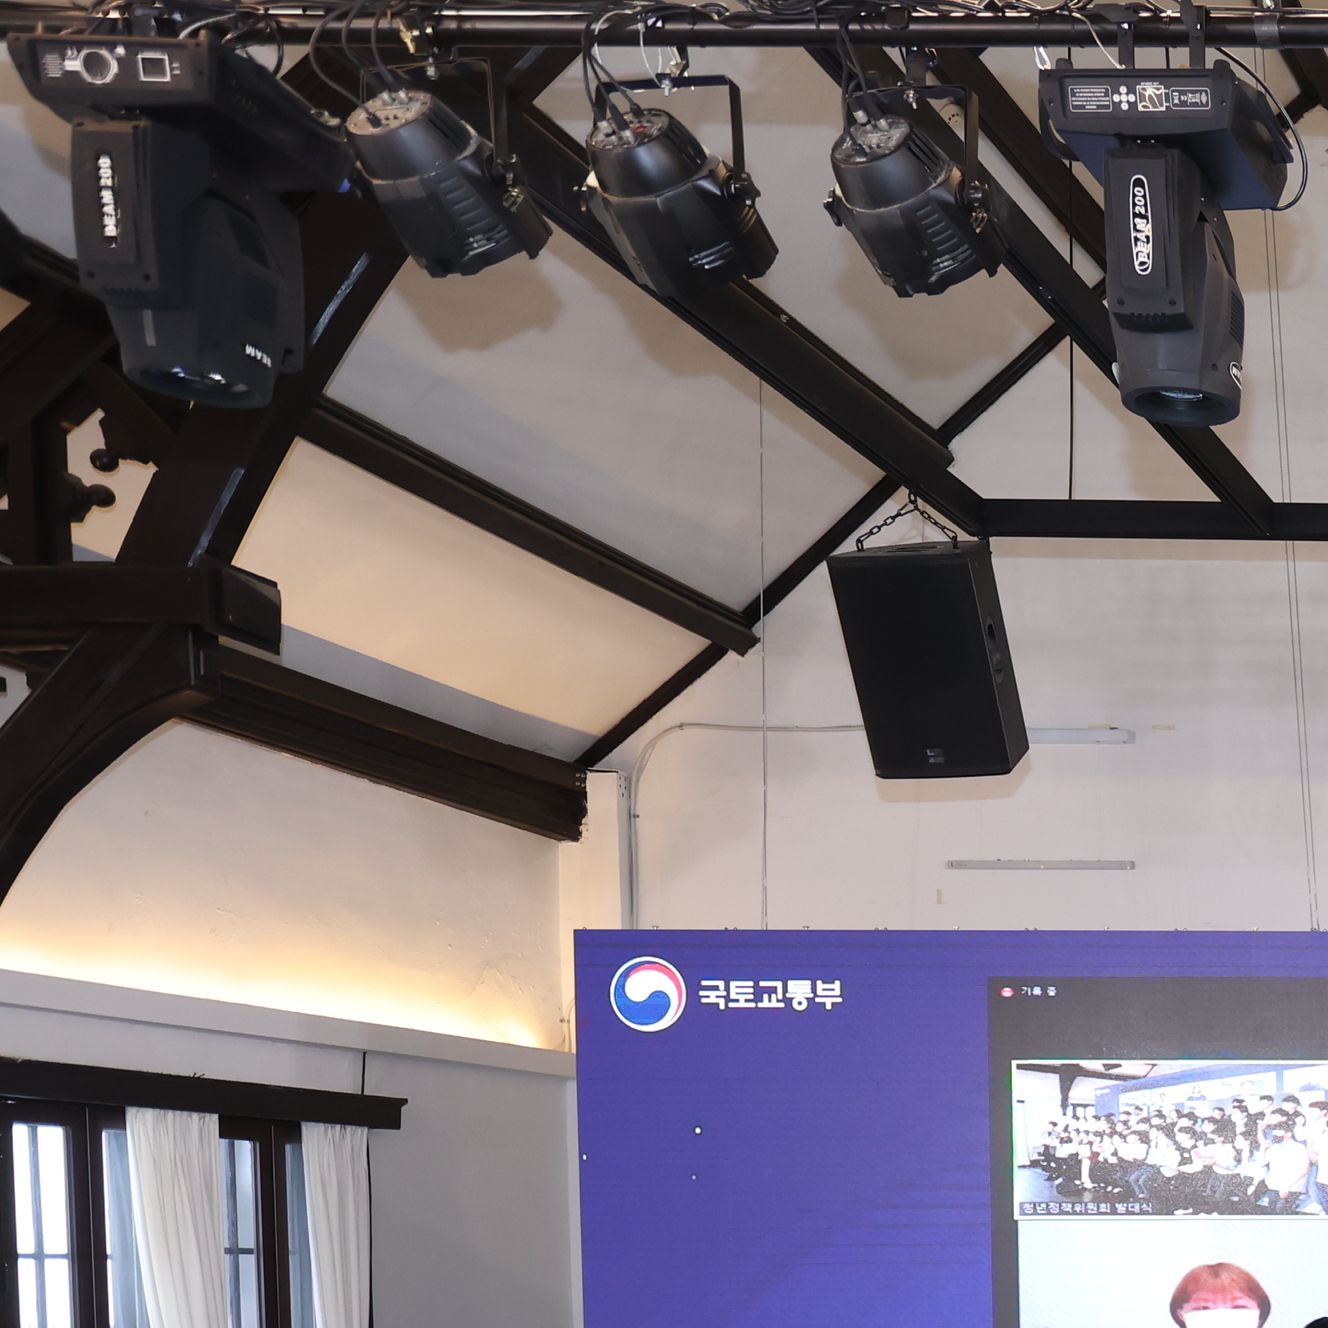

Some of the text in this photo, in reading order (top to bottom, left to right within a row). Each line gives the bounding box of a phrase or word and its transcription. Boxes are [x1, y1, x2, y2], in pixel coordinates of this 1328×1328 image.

[97, 154, 117, 237] BEAM 200
[1134, 187, 1148, 261] BEAM 200
[698, 980, 843, 1011] 국토교통부
[1021, 986, 1057, 997] 기록 중
[1022, 1202, 1154, 1213] 청년정책위원회 발대식
